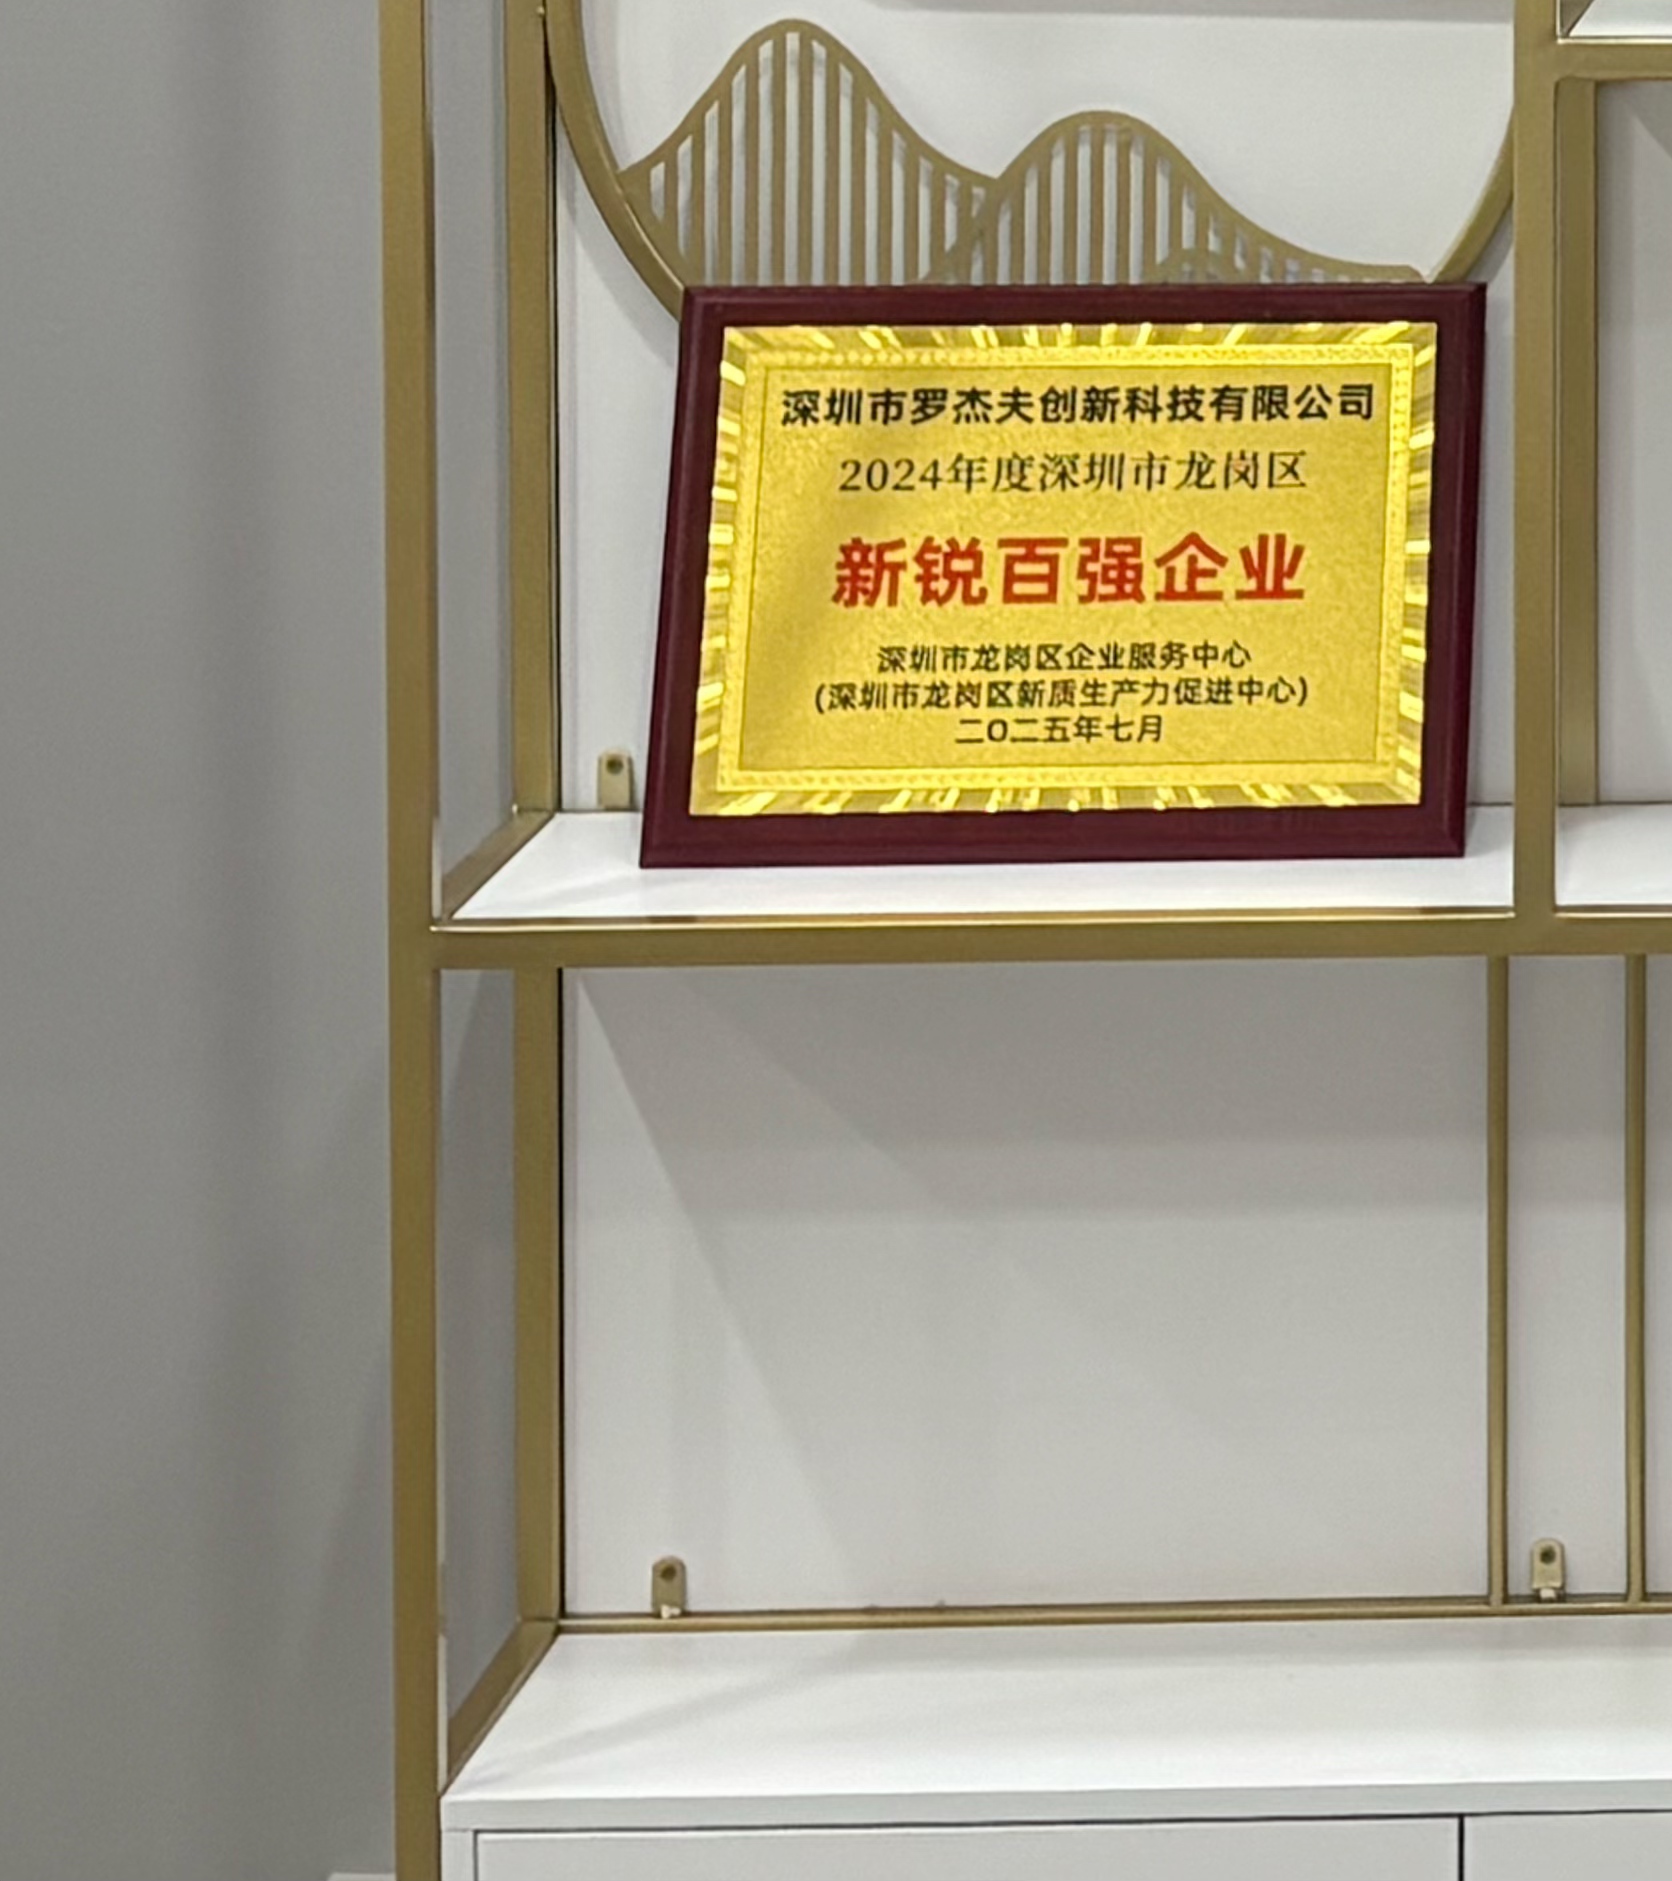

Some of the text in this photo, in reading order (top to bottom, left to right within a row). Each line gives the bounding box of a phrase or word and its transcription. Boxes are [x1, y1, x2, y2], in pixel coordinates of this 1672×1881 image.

[781, 382, 1377, 428] 深圳市罗杰夫创新科技有限公司
[838, 450, 1308, 495] 2024年度深圳市龙岗区
[832, 530, 1305, 609] 新锐百强企业
[877, 639, 1252, 673] 深圳市龙岗区企业服务中心
